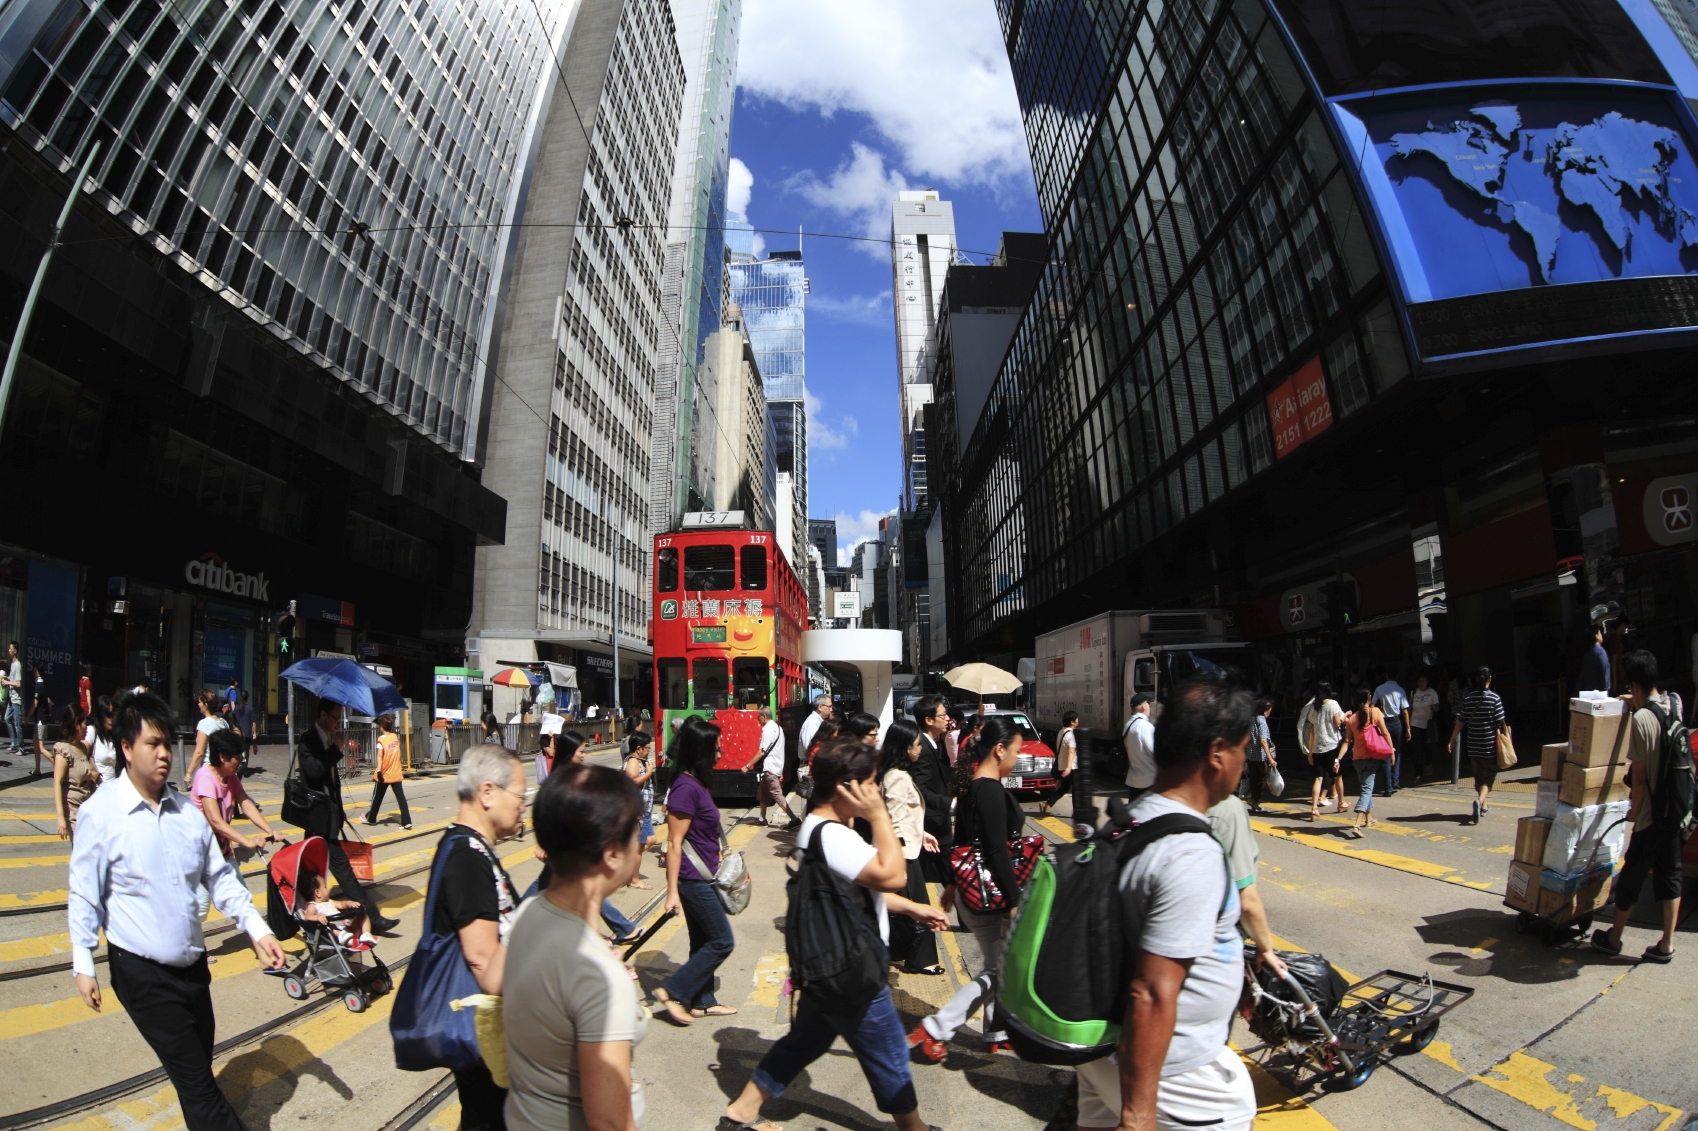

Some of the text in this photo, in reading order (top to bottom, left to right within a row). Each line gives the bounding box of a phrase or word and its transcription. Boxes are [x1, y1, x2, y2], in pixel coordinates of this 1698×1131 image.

[1461, 301, 1499, 319] BANK
[1276, 401, 1332, 451] 2151 1222
[698, 511, 729, 524] 137
[658, 538, 672, 548] 137
[750, 535, 767, 544] 137
[185, 558, 270, 602] citibank
[681, 598, 763, 618] 雅蘭床褥
[27, 646, 72, 666] SUMMER
[586, 656, 614, 669] SKECHERS
[27, 659, 55, 676] SE
